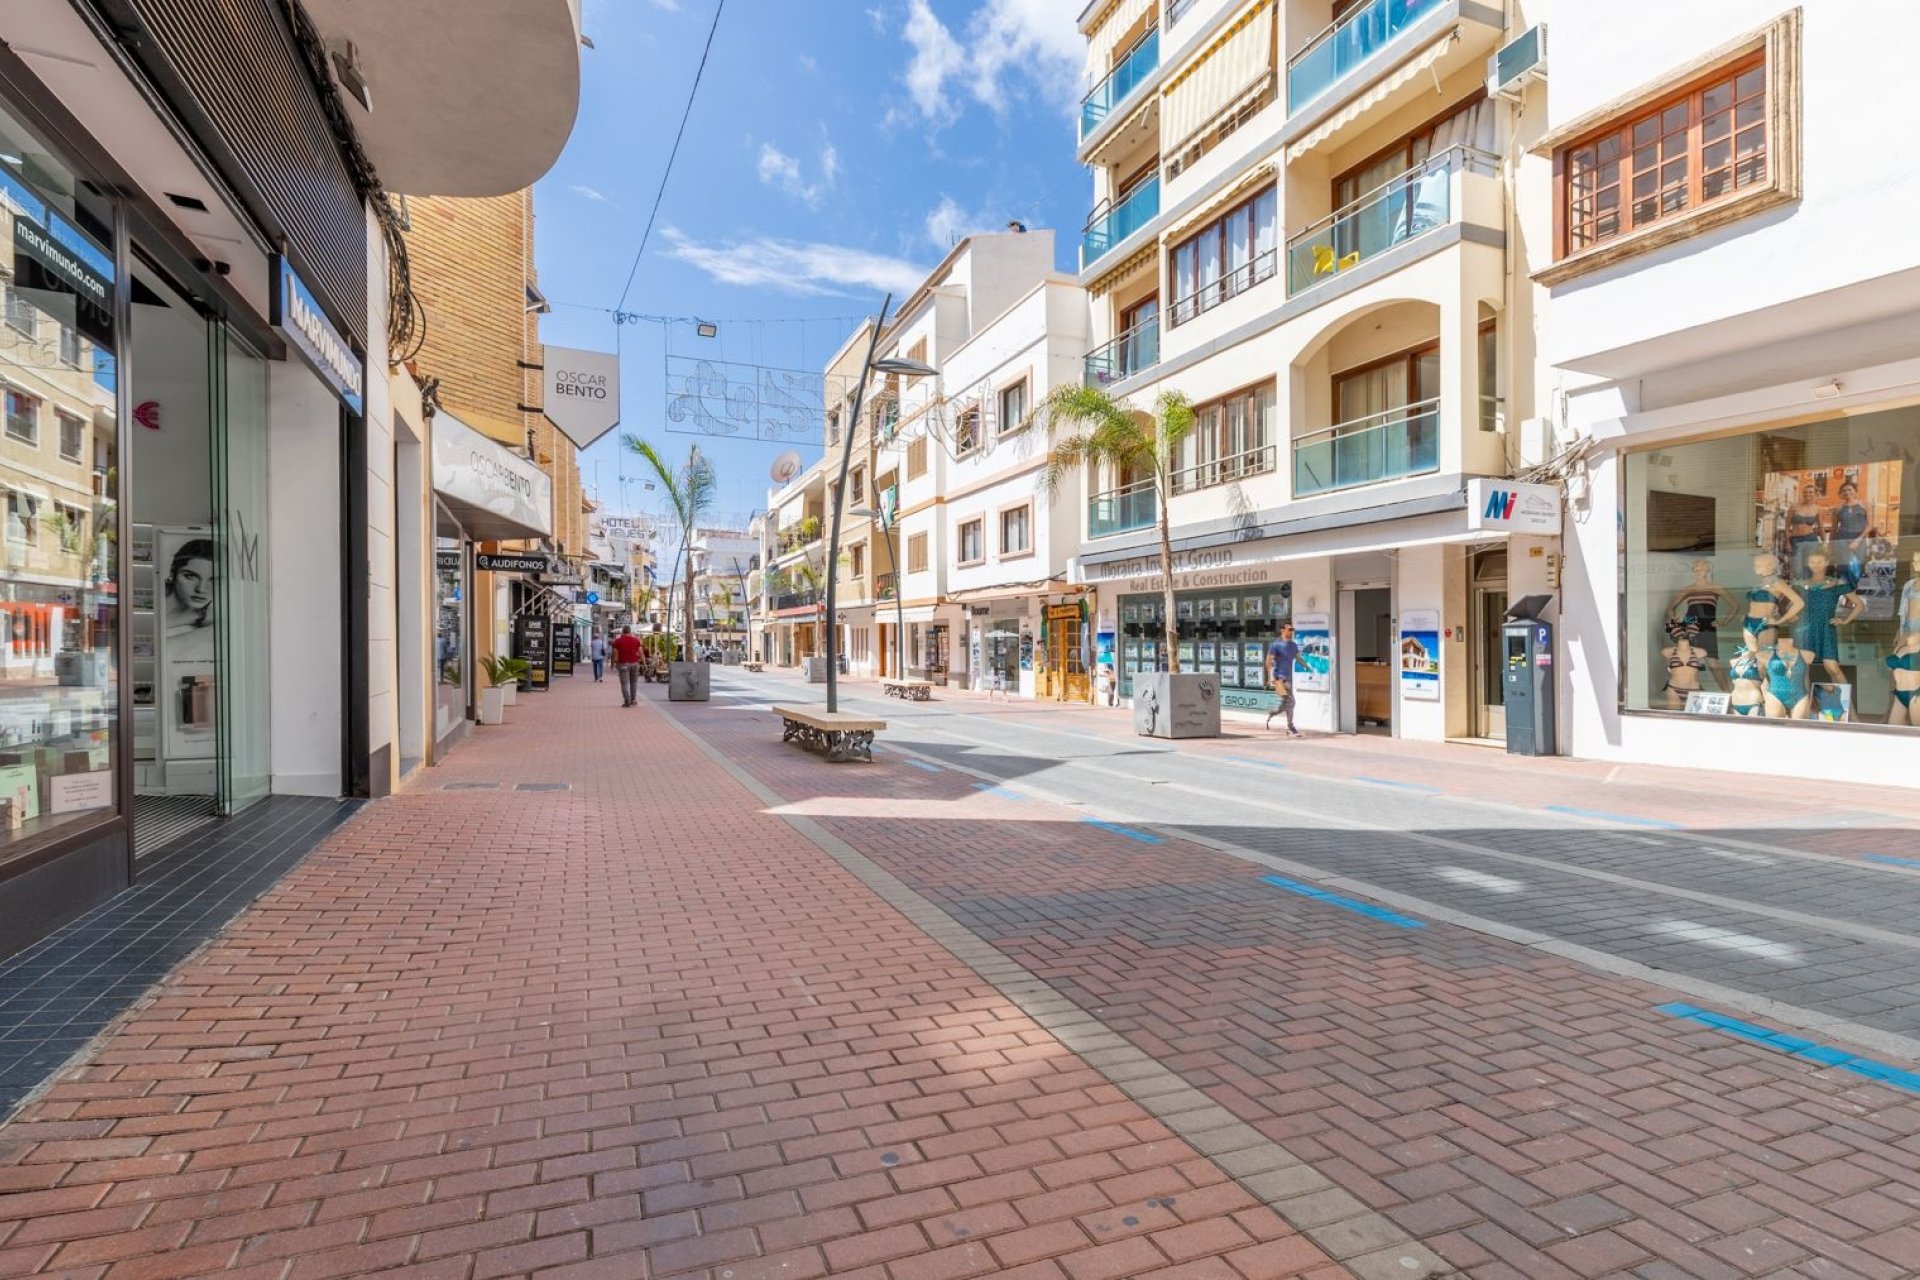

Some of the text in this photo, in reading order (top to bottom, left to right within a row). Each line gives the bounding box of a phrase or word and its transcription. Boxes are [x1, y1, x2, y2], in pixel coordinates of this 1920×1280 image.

[17, 221, 105, 298] marvimundo.com
[287, 274, 361, 396] MARVIMUNDO
[556, 369, 607, 387] OSCAR
[556, 383, 607, 399] BENTO
[503, 467, 531, 498] BENTO
[491, 559, 544, 570] AUDIFONOS
[1100, 549, 1233, 578] Moraira Invst Group
[1130, 568, 1268, 592] Real Este & Construction
[1539, 628, 1547, 642] P
[1224, 695, 1258, 707] GROUP
